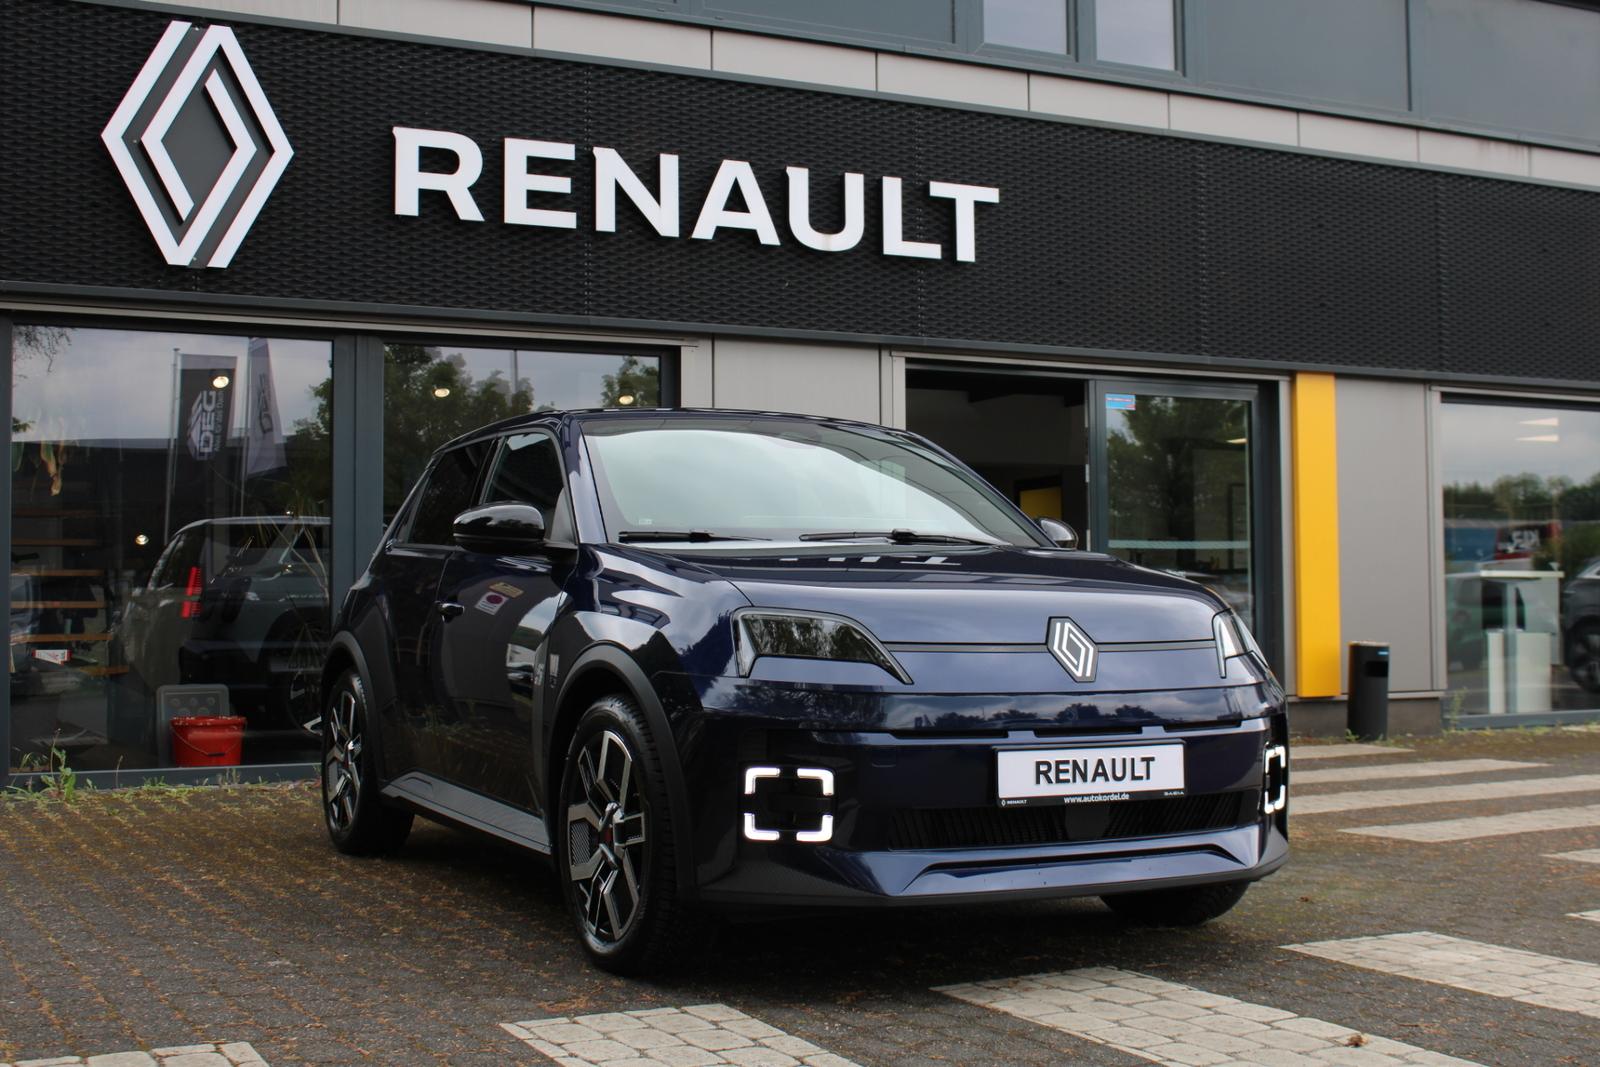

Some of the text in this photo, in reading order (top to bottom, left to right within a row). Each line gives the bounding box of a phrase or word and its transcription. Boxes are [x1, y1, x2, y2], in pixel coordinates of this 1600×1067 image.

[393, 126, 1000, 263] RENAULT
[199, 390, 216, 453] DEG
[1035, 756, 1155, 785] RENAULT
[1063, 793, 1130, 804] www.autokordel.de
